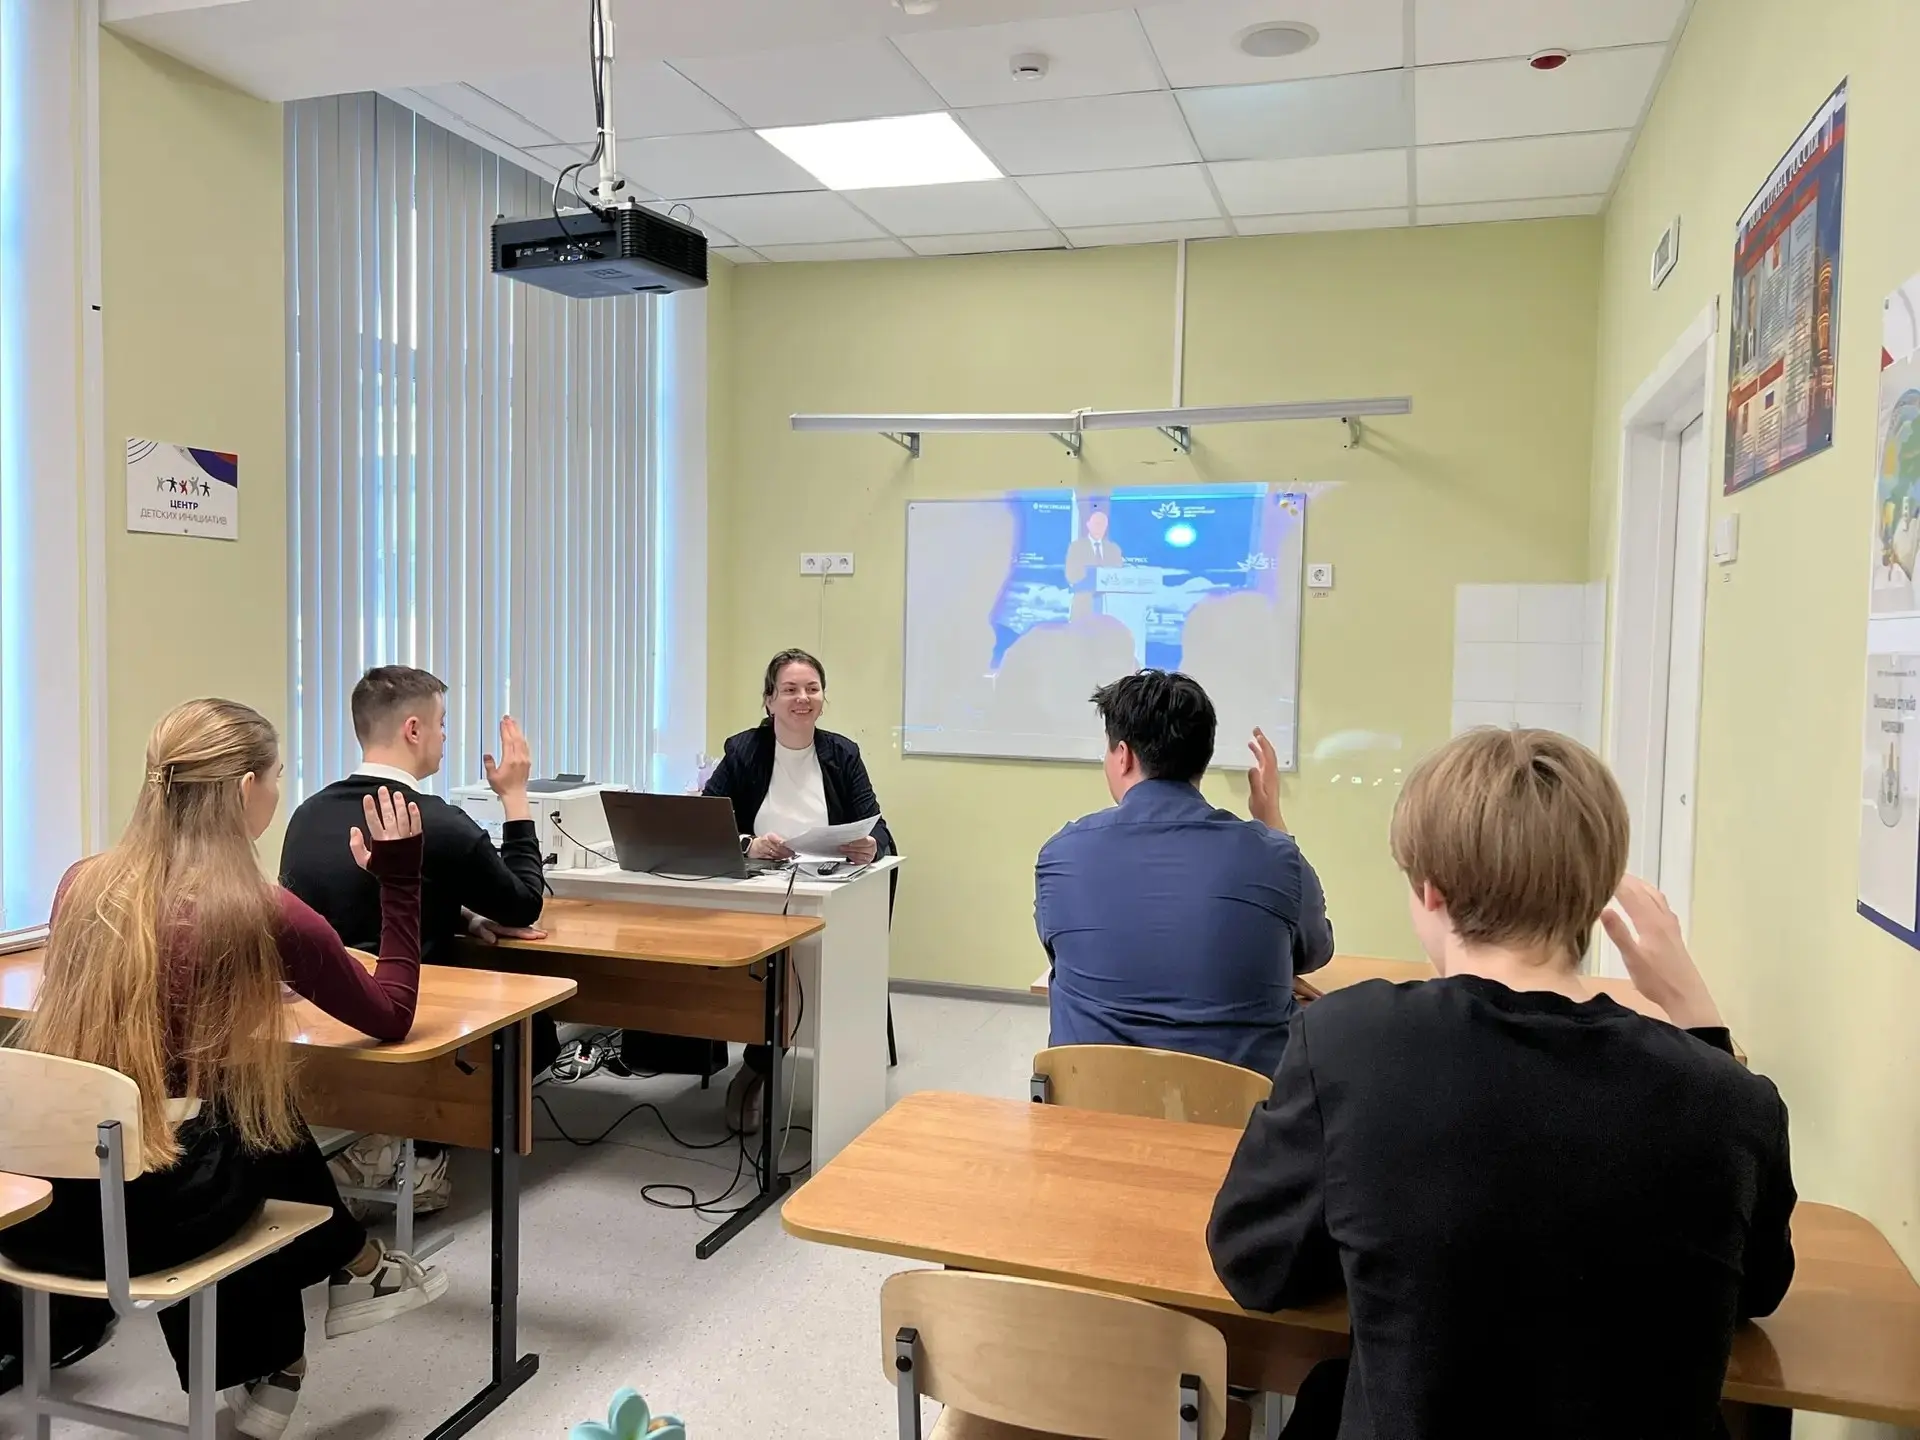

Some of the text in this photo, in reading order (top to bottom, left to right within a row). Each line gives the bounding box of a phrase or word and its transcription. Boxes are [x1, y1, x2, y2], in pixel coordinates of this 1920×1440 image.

[1762, 171, 1788, 213] СТРАНА
[1788, 131, 1819, 182] РОССИЯ
[170, 499, 198, 509] ЦЕНТР
[140, 508, 227, 525] ДЕТСКИХ ИНИЦИАТИВ
